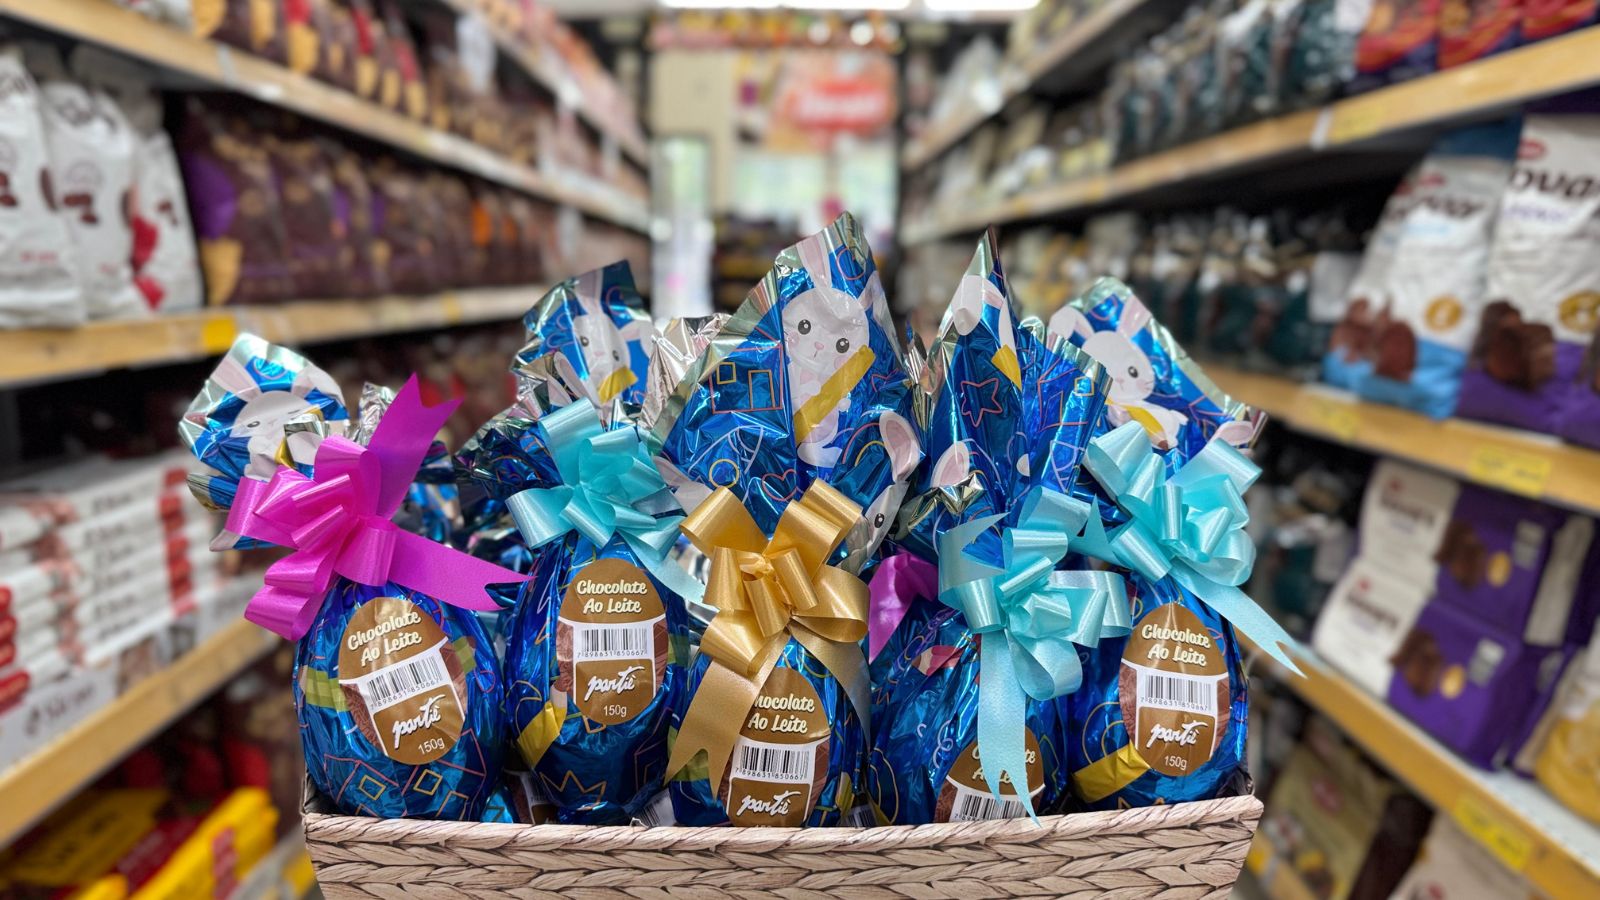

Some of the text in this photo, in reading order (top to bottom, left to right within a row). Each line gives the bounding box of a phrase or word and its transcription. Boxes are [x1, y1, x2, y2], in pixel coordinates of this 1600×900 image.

[576, 579, 648, 595] Chocolate
[583, 597, 642, 614] Ao Leite
[347, 610, 422, 651] Chocolate
[1141, 624, 1211, 649] Chocolate
[361, 631, 422, 667] Ao Leite
[1147, 645, 1207, 667] Ao Leite
[603, 704, 627, 718] 150g
[754, 692, 815, 713] hocolate
[747, 712, 808, 734] Ao Leite
[418, 737, 445, 755] 150g
[1164, 755, 1188, 771] 150g
